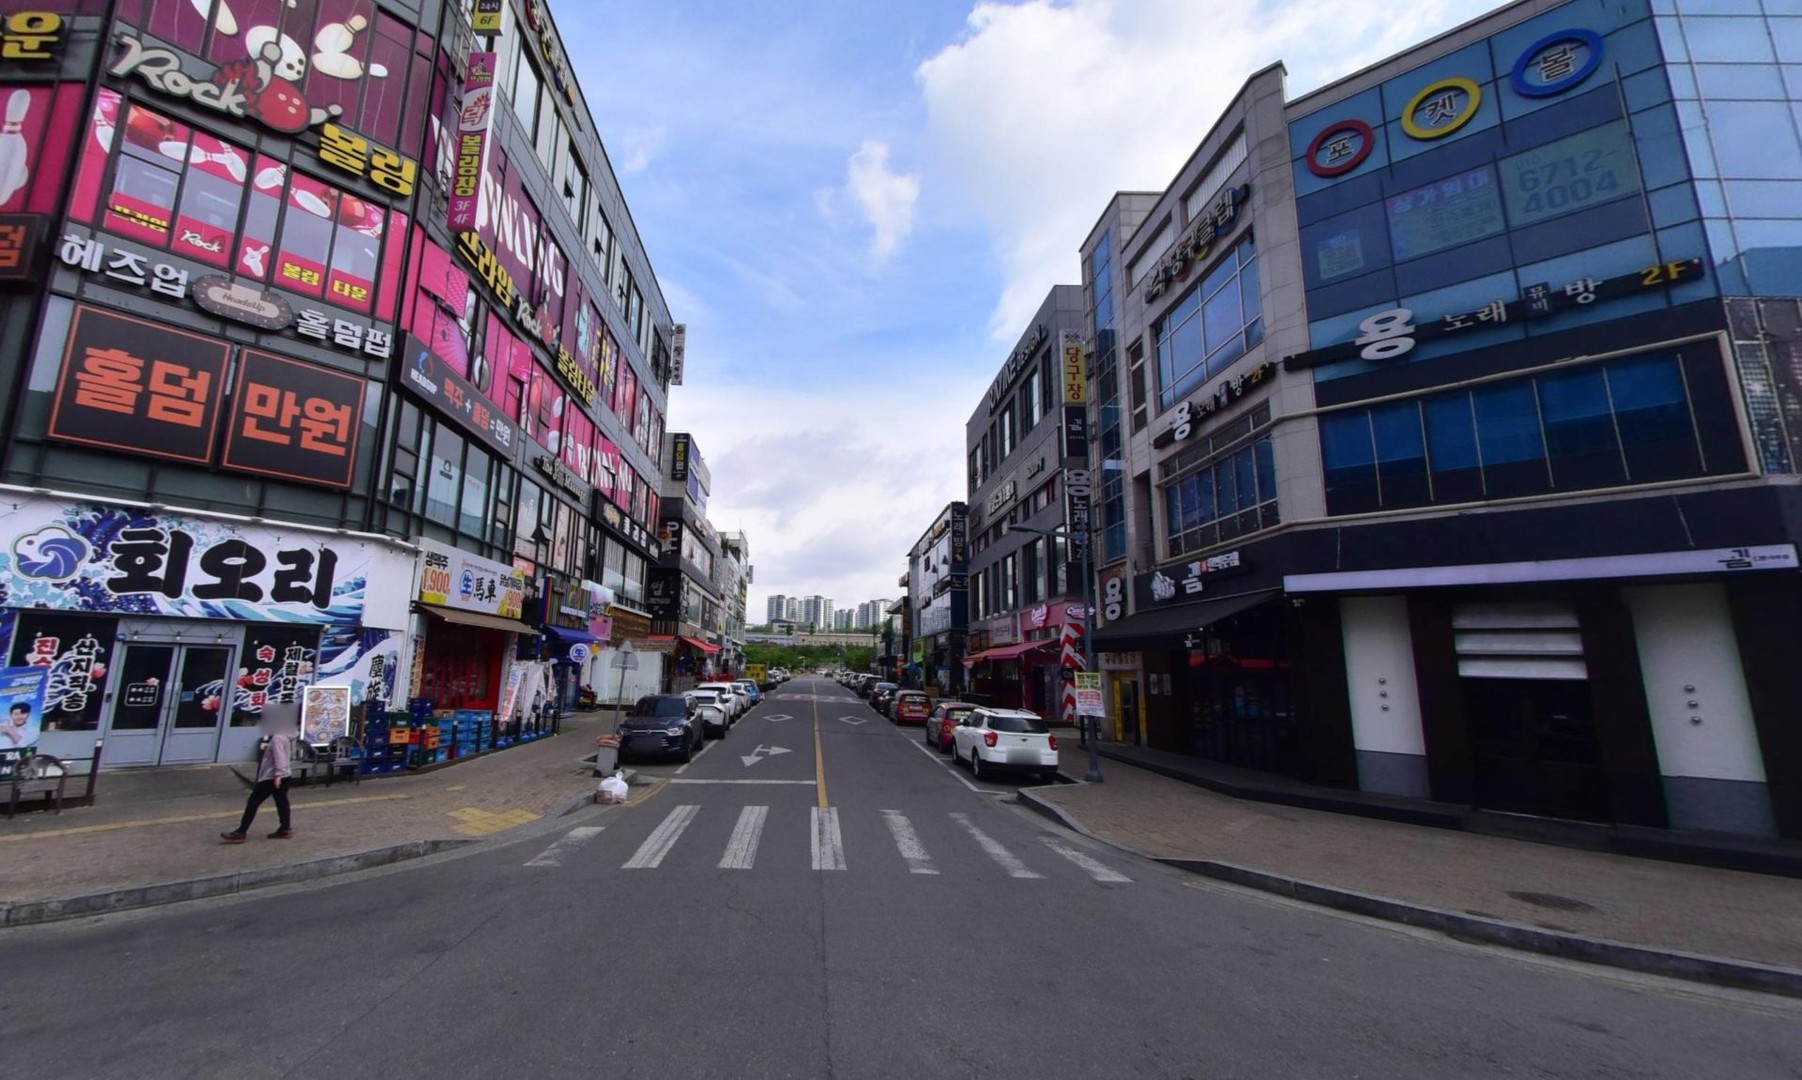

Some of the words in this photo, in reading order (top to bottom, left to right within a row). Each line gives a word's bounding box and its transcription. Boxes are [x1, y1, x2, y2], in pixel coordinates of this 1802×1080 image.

[480, 15, 495, 25] 6F
[109, 33, 247, 117] Rock
[319, 123, 416, 196] 볼링
[455, 134, 482, 197] 볼링장
[1327, 136, 1354, 163] 포
[454, 200, 472, 211] 3F
[1524, 169, 1618, 214] 4004
[180, 229, 221, 252] Rock
[453, 213, 471, 224] 4F
[60, 233, 188, 299] 헤즈업
[282, 262, 319, 286] 볼링
[458, 232, 513, 307] 프라임
[222, 292, 266, 313] HeadsUp
[333, 279, 368, 302] 타운
[1355, 308, 1416, 360] 용
[1444, 299, 1507, 331] 노래
[1562, 277, 1603, 306] 방
[1642, 260, 1689, 287] 2F
[297, 308, 392, 359] 홀덤펍
[516, 295, 542, 339] Rock
[558, 343, 598, 405] 볼링타운
[1065, 346, 1083, 400] 당구장
[75, 347, 211, 428] 홀덤
[242, 381, 353, 457] 만원
[1171, 400, 1192, 441] 용
[495, 419, 511, 448] 만원
[1064, 468, 1091, 497] 용
[107, 527, 339, 610] 회오리
[425, 551, 449, 570] 생맥주
[460, 573, 472, 594] 生
[474, 577, 497, 603] 馬車
[1105, 577, 1122, 621] 용
[63, 639, 98, 711] 산지직송
[250, 645, 275, 707] 숙성회
